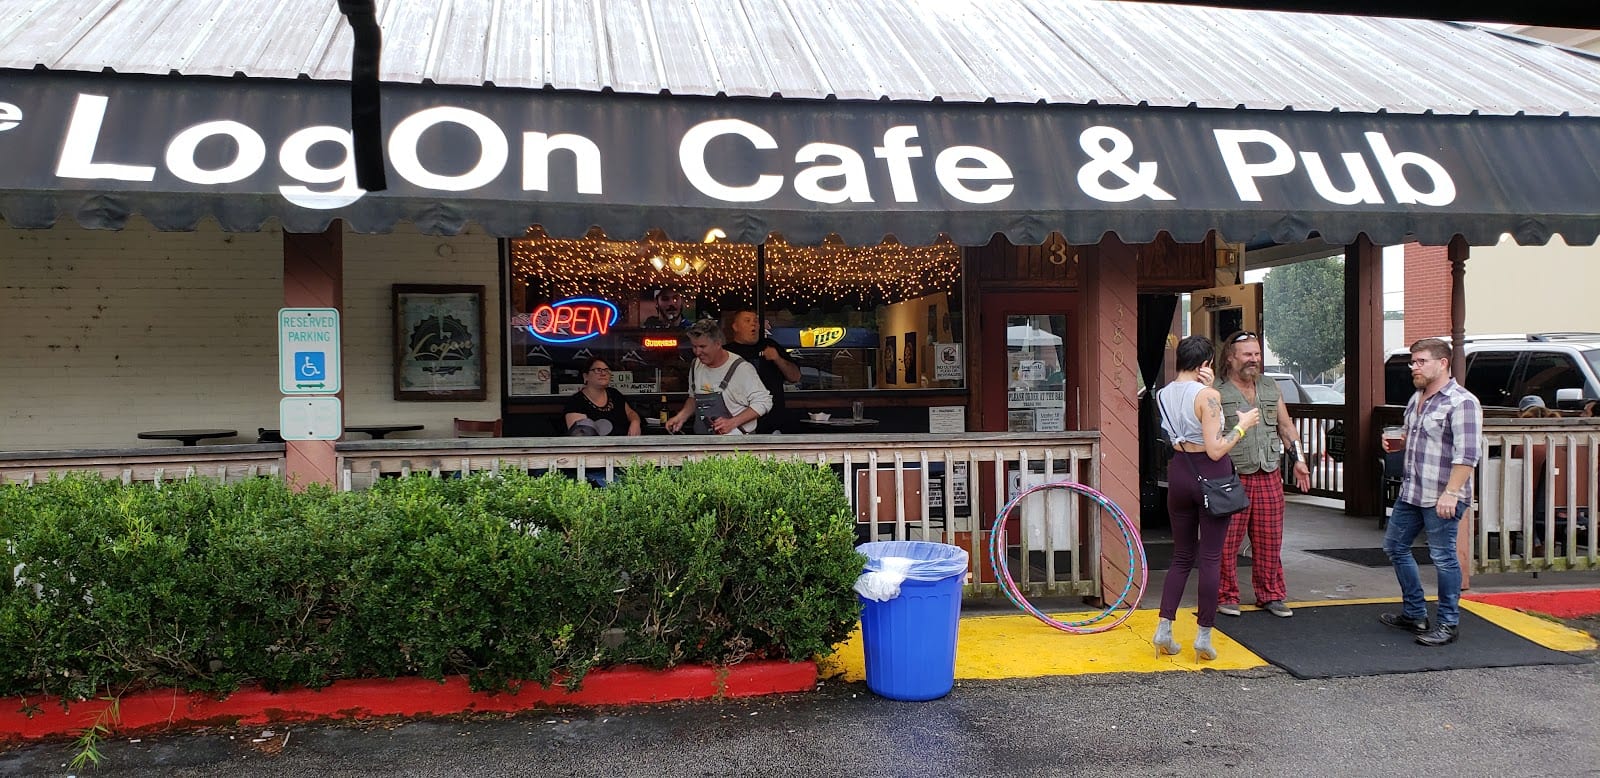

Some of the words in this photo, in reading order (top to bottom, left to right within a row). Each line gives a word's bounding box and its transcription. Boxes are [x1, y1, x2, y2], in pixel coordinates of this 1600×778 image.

[679, 118, 1015, 204] Cafe
[1077, 125, 1177, 203] &
[1213, 129, 1457, 207] Pub
[283, 316, 335, 328] RESERVED
[532, 306, 610, 334] OPEN
[288, 331, 330, 343] PARKING
[1008, 392, 1024, 401] PLEASE
